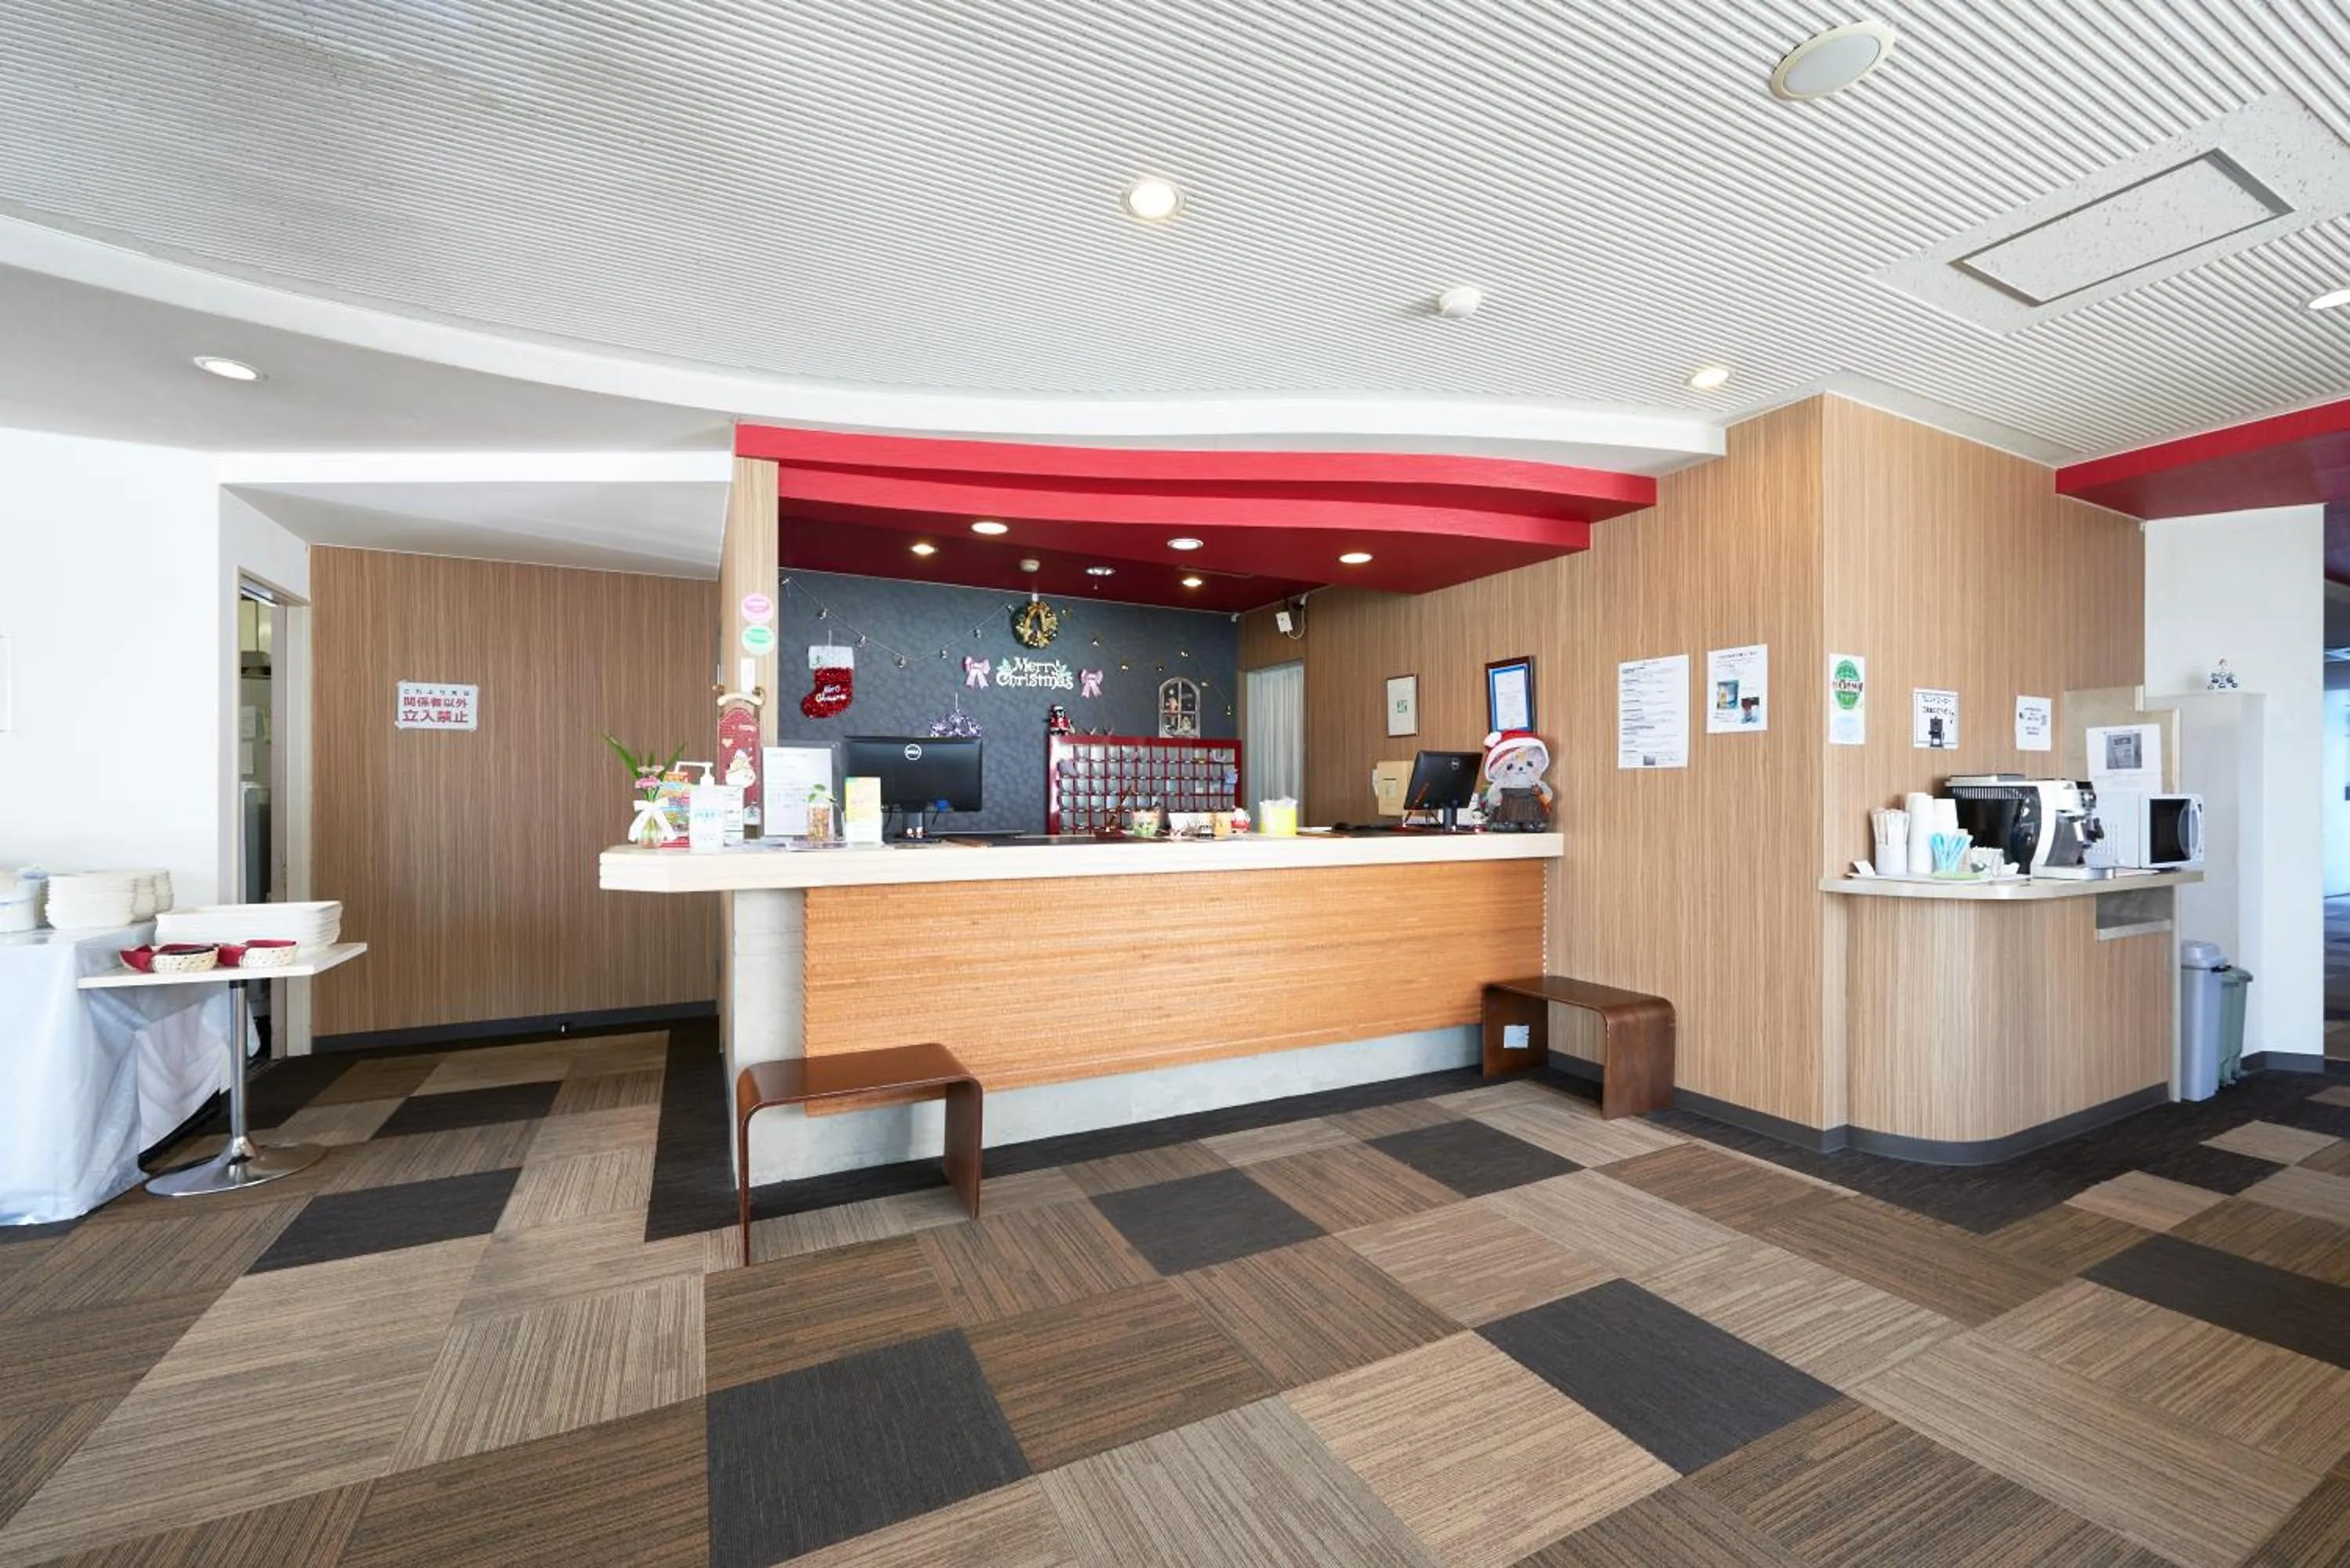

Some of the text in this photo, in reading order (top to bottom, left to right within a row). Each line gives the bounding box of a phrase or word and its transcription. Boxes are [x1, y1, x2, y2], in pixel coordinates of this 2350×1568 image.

[1009, 656, 1060, 676] Merry
[996, 670, 1073, 690] Christmas
[403, 710, 469, 723] 立入禁止
